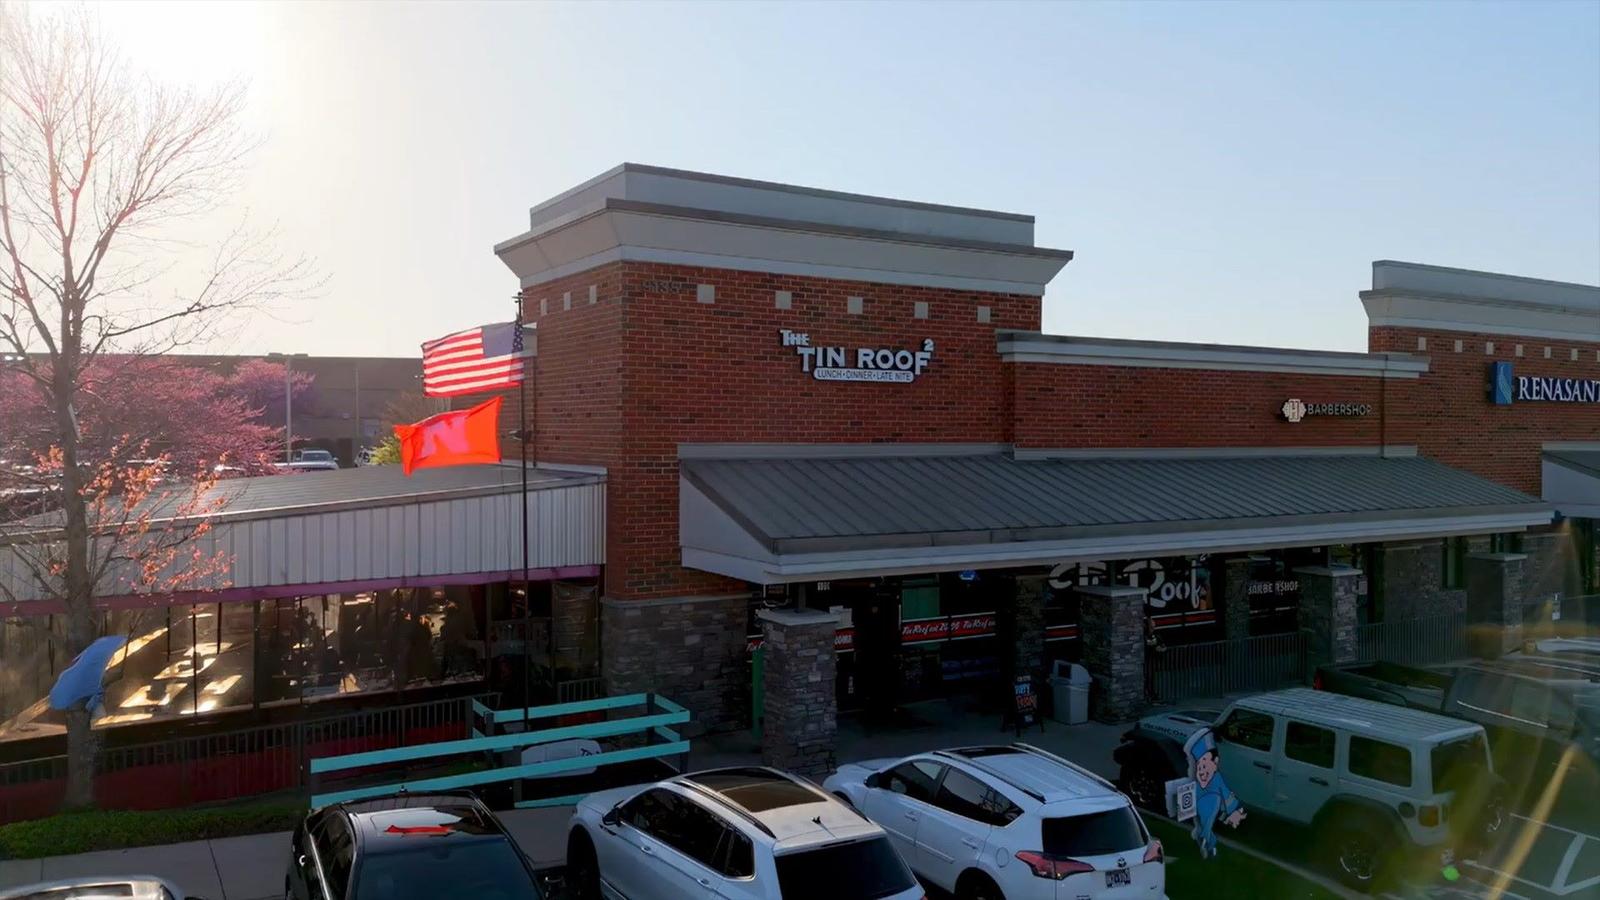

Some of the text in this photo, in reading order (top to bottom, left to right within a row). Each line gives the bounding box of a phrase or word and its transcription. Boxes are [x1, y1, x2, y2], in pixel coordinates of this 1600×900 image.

[797, 338, 934, 375] TIN ROOF 2
[817, 370, 912, 381] LUNCH DINNER LATE NITE
[1307, 403, 1373, 416] BARBERSHOP
